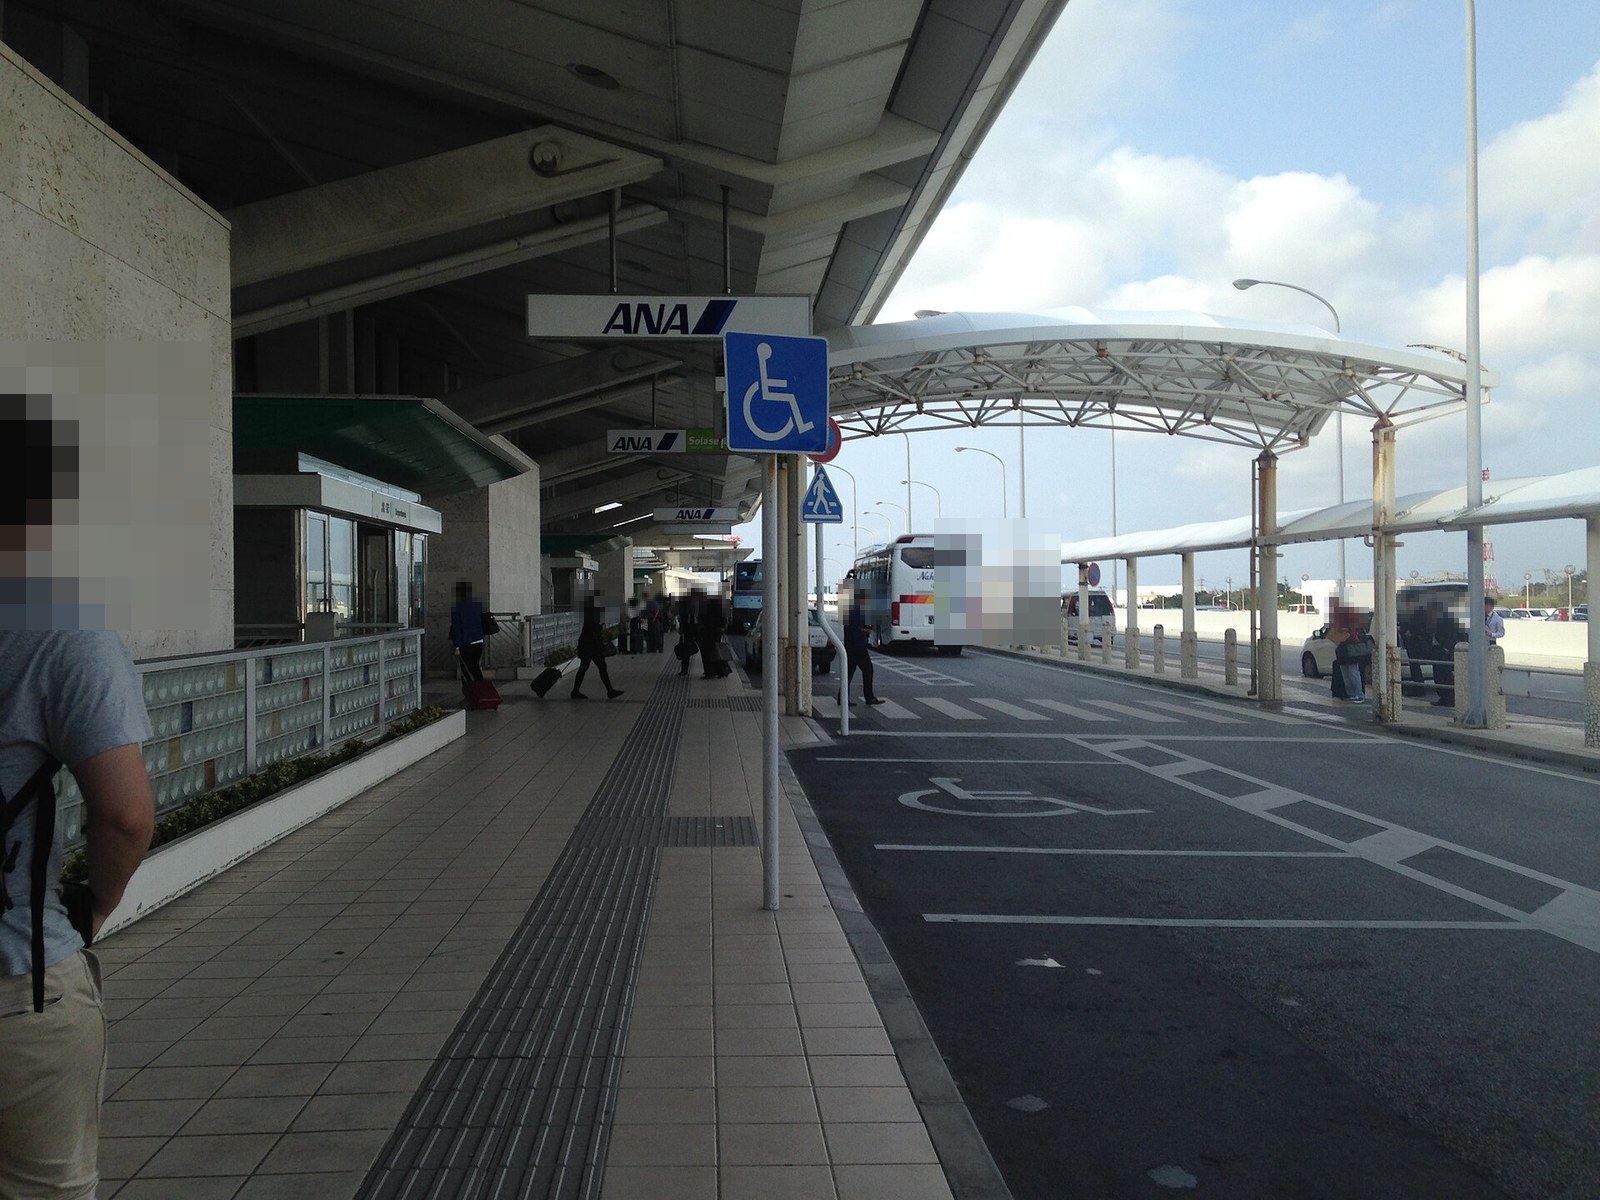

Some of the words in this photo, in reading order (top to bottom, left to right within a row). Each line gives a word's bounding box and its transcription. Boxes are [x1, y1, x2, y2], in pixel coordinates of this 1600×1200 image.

[602, 303, 689, 334] ANA
[612, 437, 652, 450] ANA
[687, 436, 727, 446] Solase
[676, 510, 701, 519] ANA
